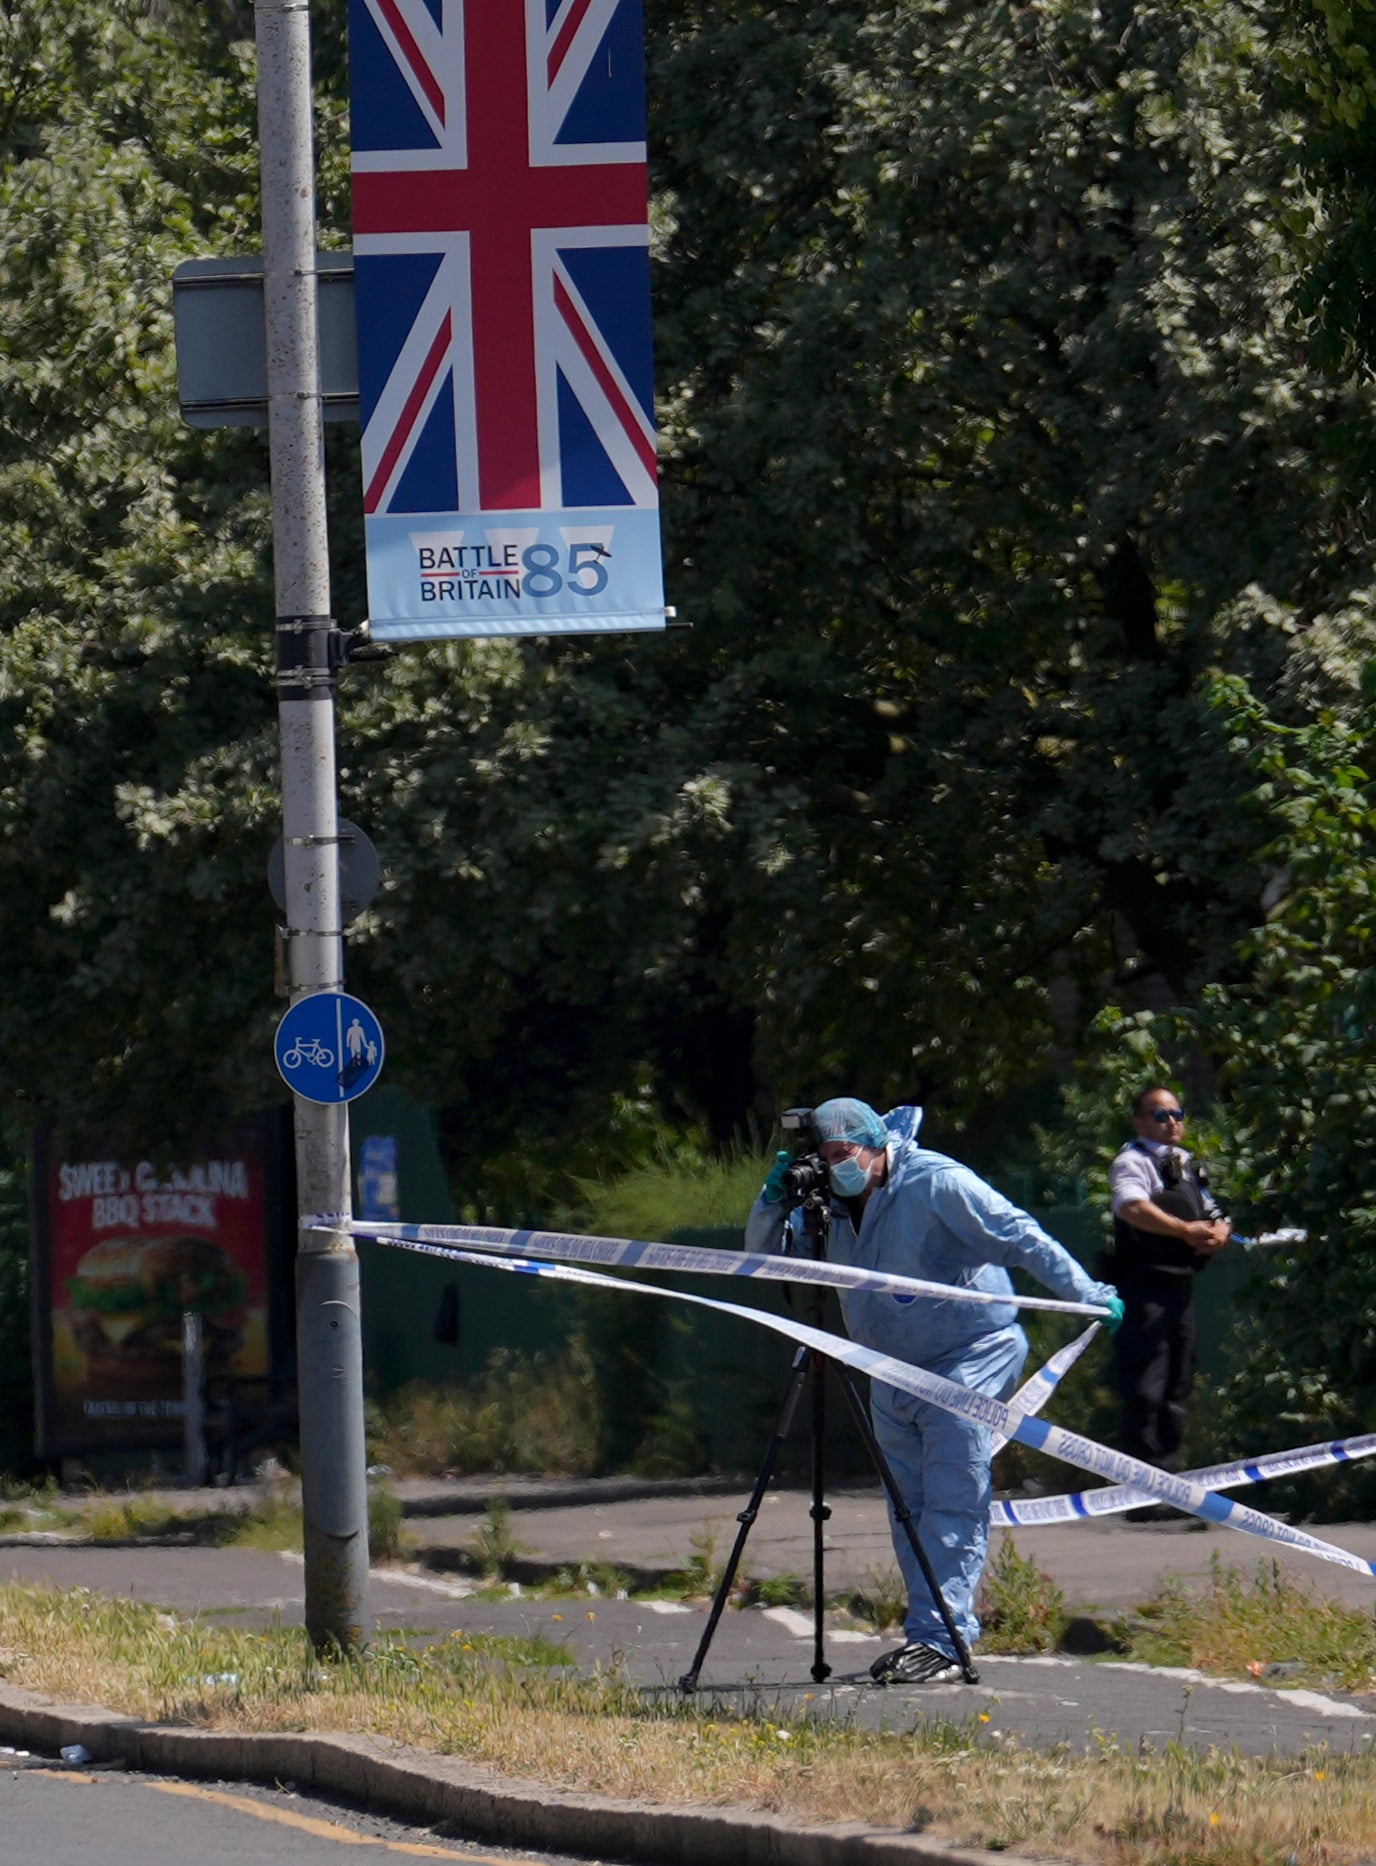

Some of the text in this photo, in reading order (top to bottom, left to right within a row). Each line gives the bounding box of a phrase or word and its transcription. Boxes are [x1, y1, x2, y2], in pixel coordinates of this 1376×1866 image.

[419, 544, 519, 570] BATTLE
[521, 542, 610, 598] 85
[461, 568, 478, 579] OF
[420, 577, 521, 602] BRITAIN
[92, 1194, 218, 1230] BBQ STACK
